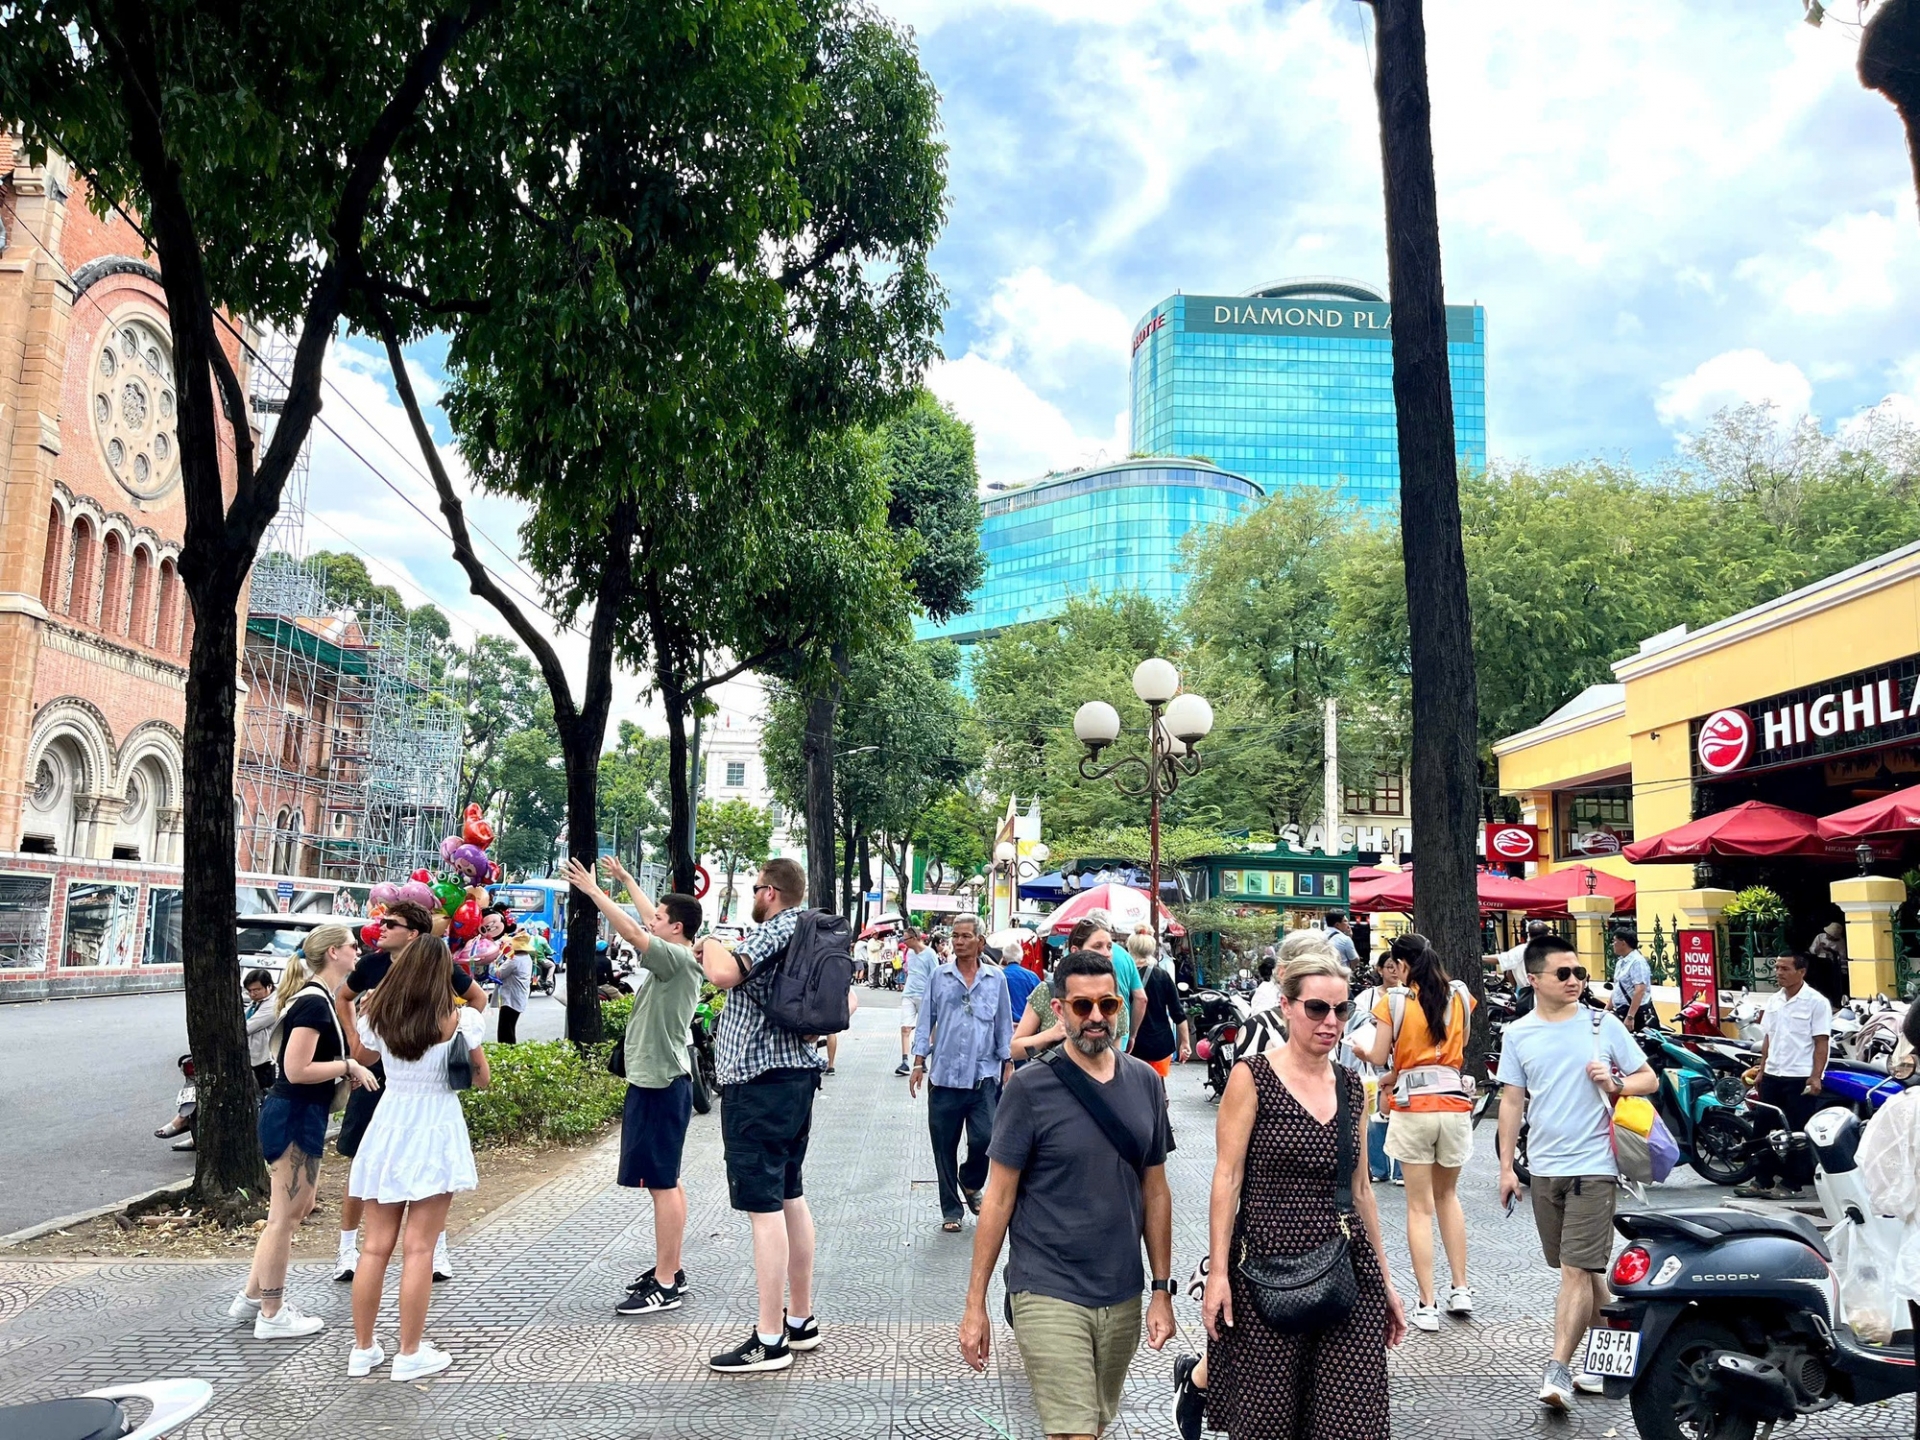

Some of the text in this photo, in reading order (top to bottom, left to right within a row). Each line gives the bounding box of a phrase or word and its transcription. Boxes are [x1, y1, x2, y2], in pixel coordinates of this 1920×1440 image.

[1214, 304, 1343, 328] DIAMOND
[1684, 952, 1710, 964] NOW
[1684, 964, 1712, 976] OPEN
[1691, 1273, 1760, 1282] SCOOPY
[1596, 1331, 1632, 1353] 59-FA
[1589, 1352, 1633, 1375] 098.42
